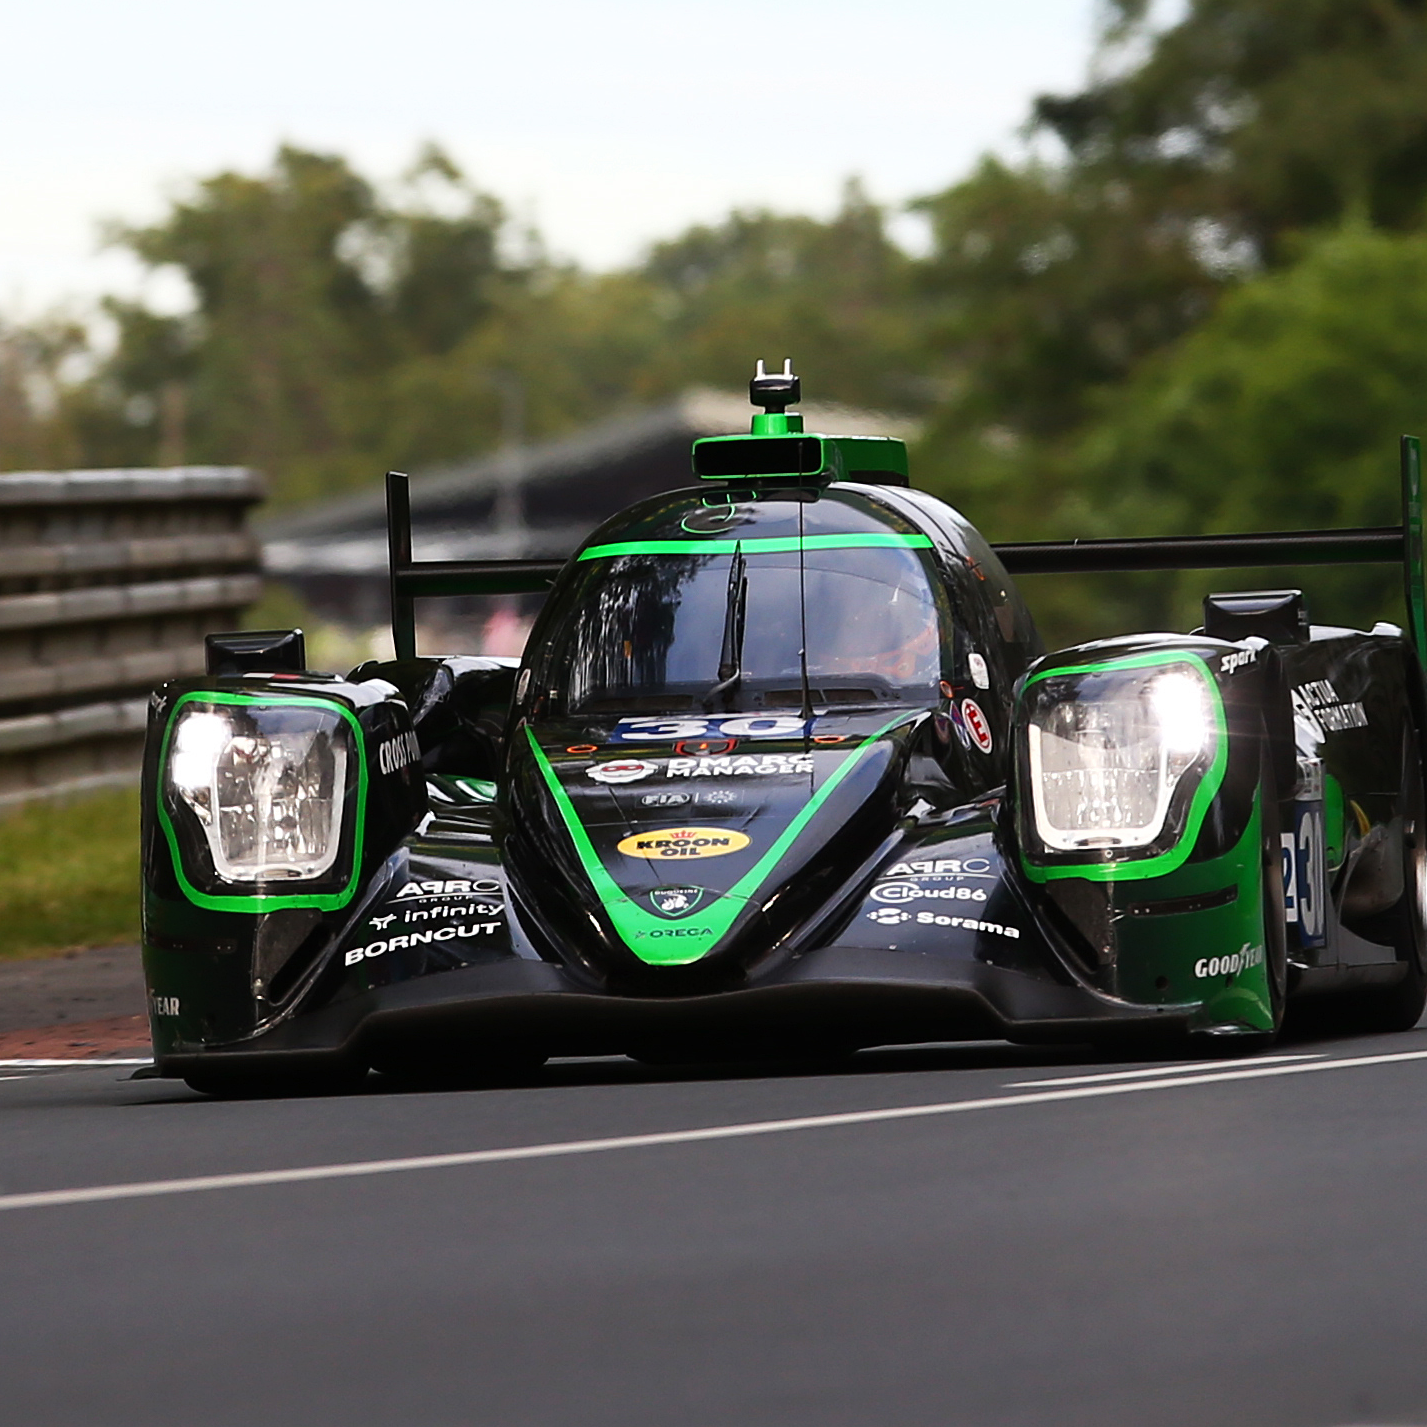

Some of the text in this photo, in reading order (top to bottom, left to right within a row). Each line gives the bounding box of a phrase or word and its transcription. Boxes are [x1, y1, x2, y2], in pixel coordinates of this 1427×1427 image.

[621, 716, 811, 740] 30
[379, 733, 407, 775] CROSS
[668, 754, 814, 770] DMARC
[666, 764, 814, 778] MANAGER
[636, 837, 730, 850] KROON
[660, 847, 701, 857] OIL
[882, 885, 987, 901] Cloud86
[404, 903, 506, 924] infinity
[916, 911, 1020, 939] Sorama
[344, 921, 502, 967] BORNCUT
